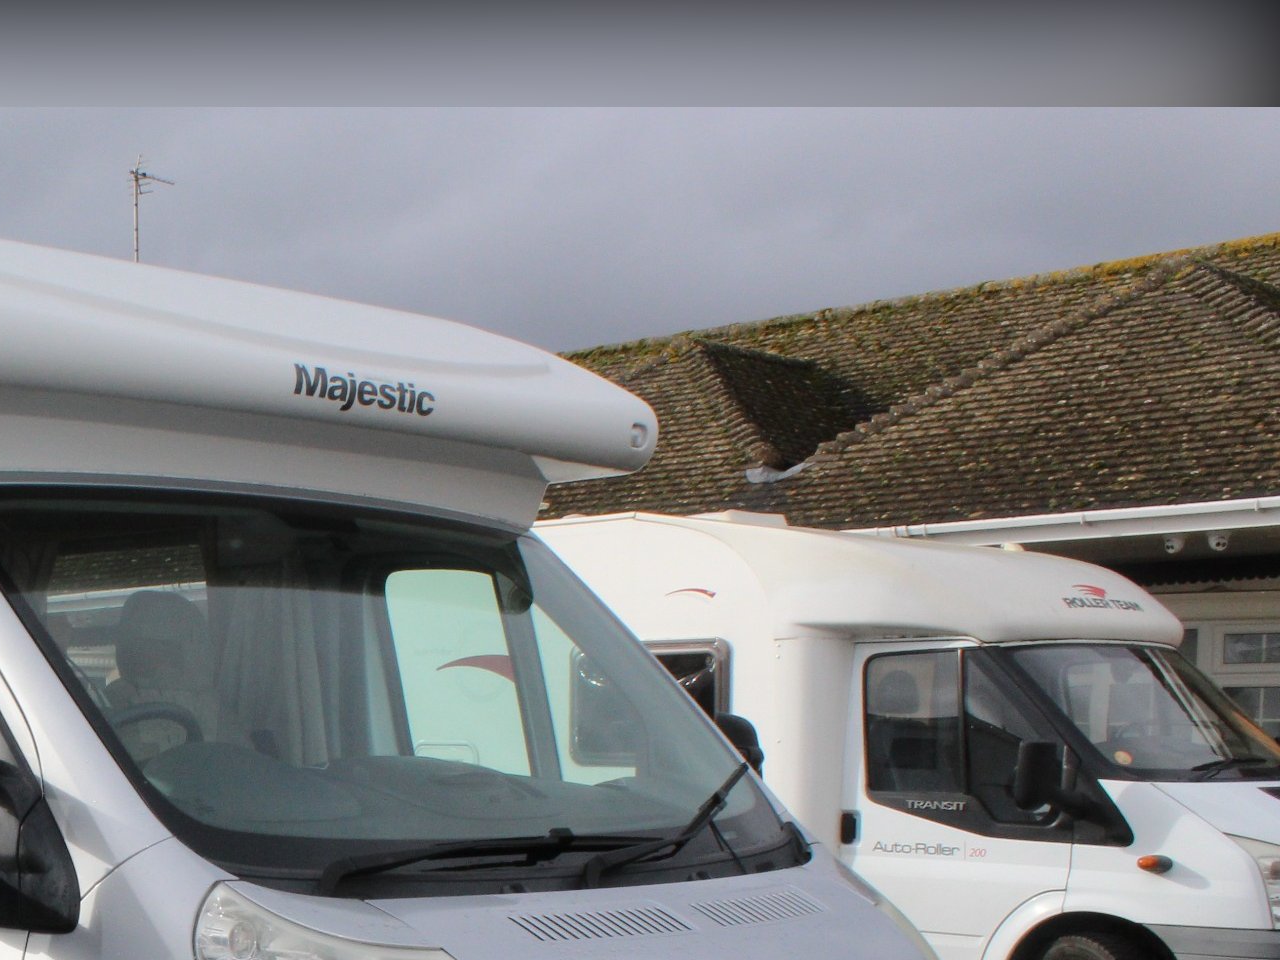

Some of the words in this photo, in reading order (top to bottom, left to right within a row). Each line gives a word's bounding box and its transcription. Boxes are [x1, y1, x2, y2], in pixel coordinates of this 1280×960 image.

[293, 362, 436, 417] Majestic
[1062, 597, 1113, 609] ROLLER
[1109, 599, 1145, 612] TEAM
[906, 799, 966, 811] TRANSIT
[872, 841, 961, 856] Auto-Roller
[969, 848, 987, 857] 200
